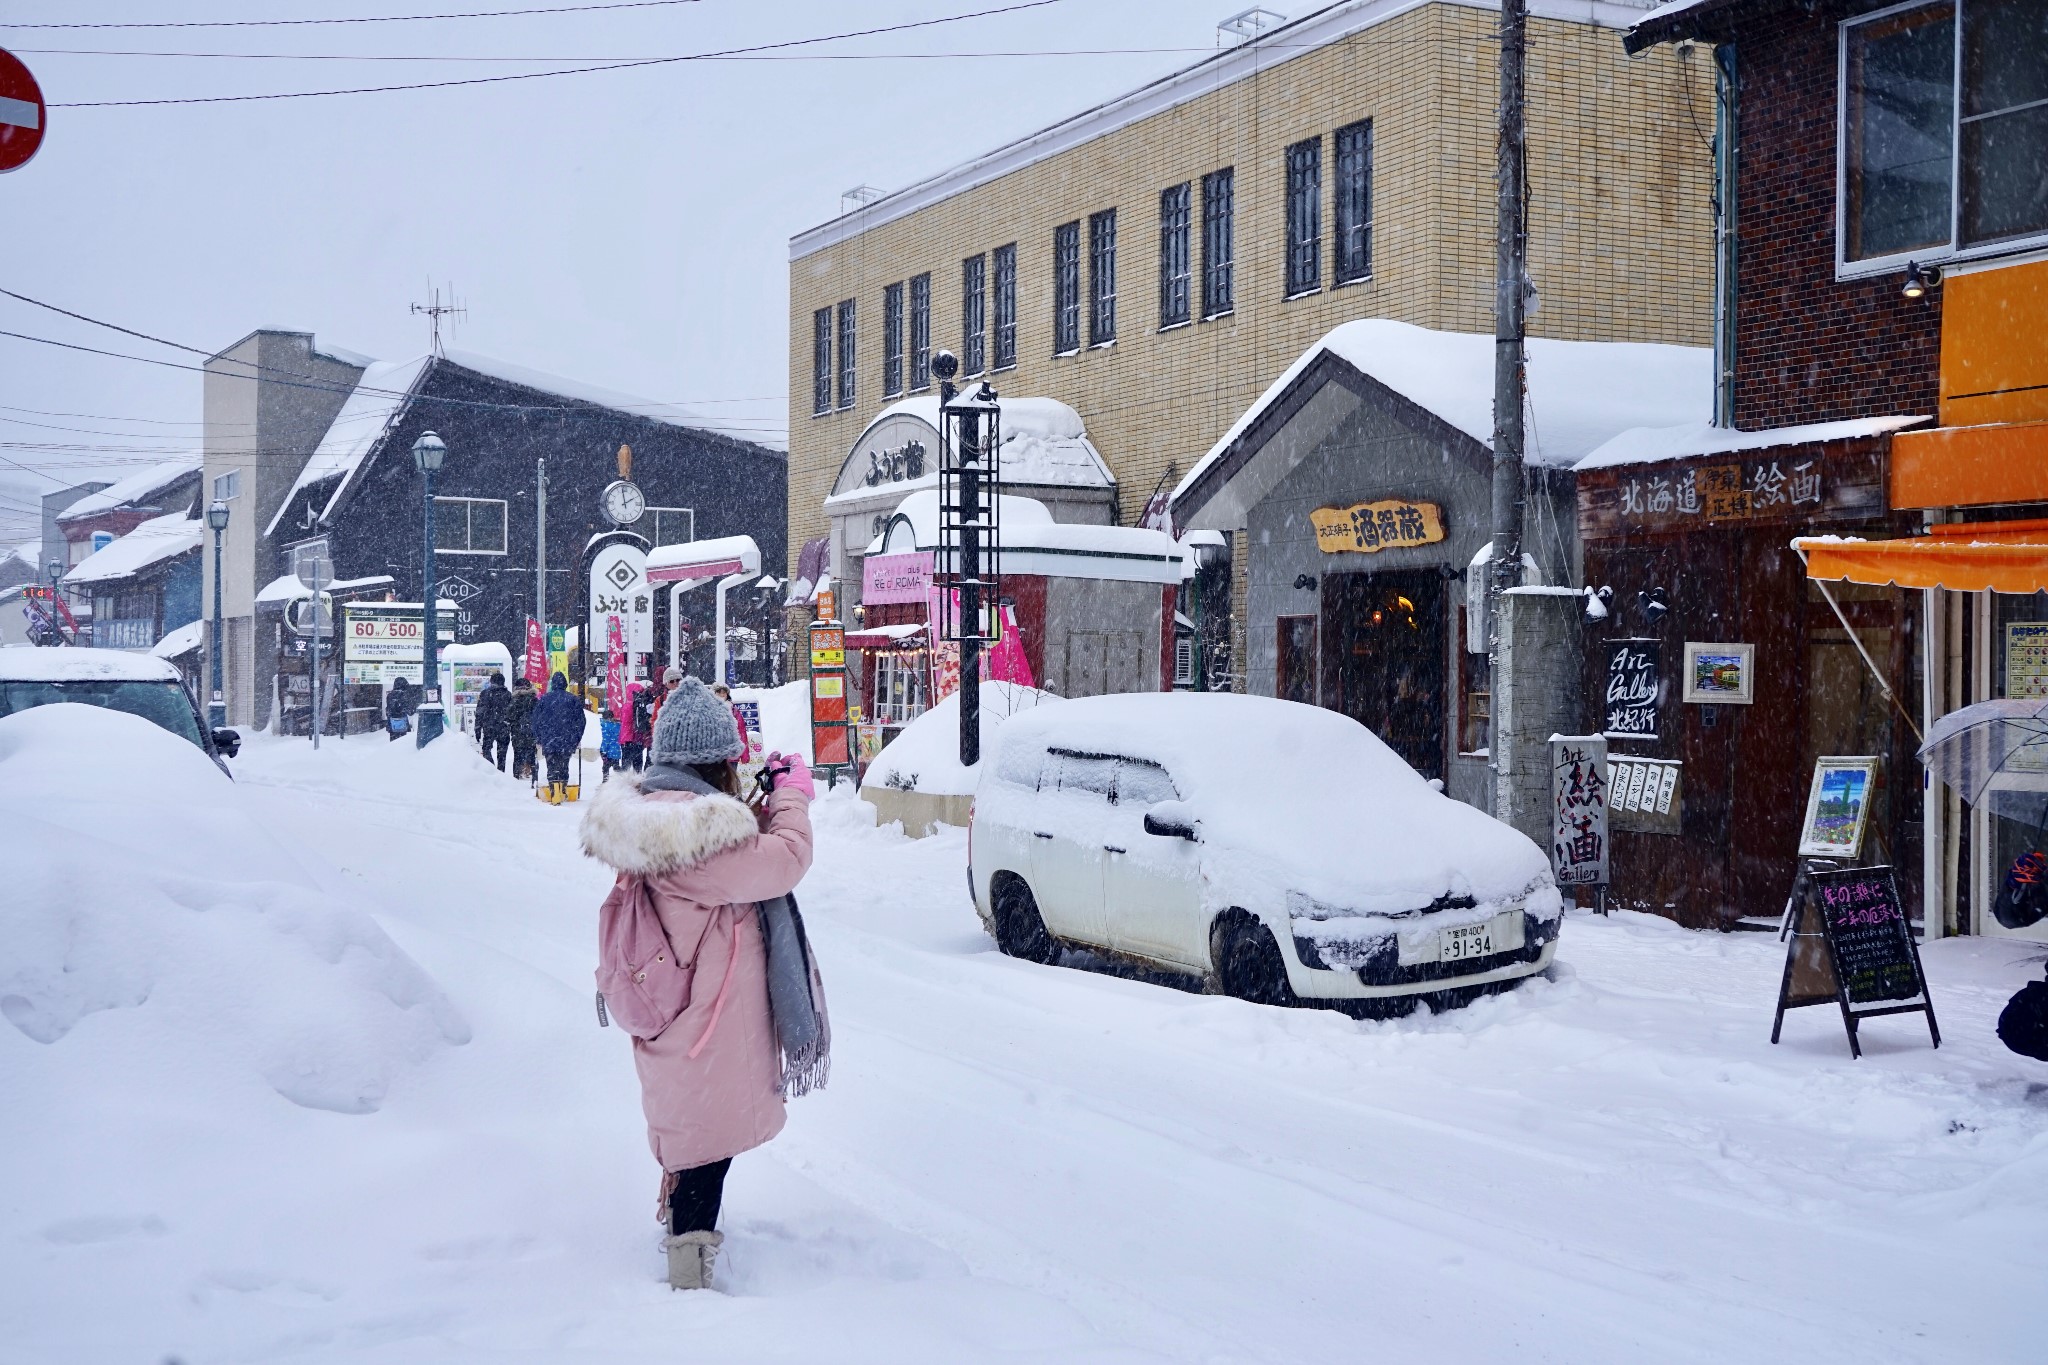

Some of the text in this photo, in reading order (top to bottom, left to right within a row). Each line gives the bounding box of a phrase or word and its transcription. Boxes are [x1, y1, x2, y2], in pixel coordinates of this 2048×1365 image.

[1621, 461, 1821, 516] 北海道 絵画
[440, 584, 469, 597] ACO
[1610, 647, 1655, 670] Art
[1606, 669, 1658, 708] Gallery
[1606, 707, 1656, 731] 北紀行
[1559, 745, 1592, 765] Art
[1643, 770, 1659, 806] 富良野
[1558, 867, 1600, 883] Gallery
[1452, 936, 1491, 957] 91-94
